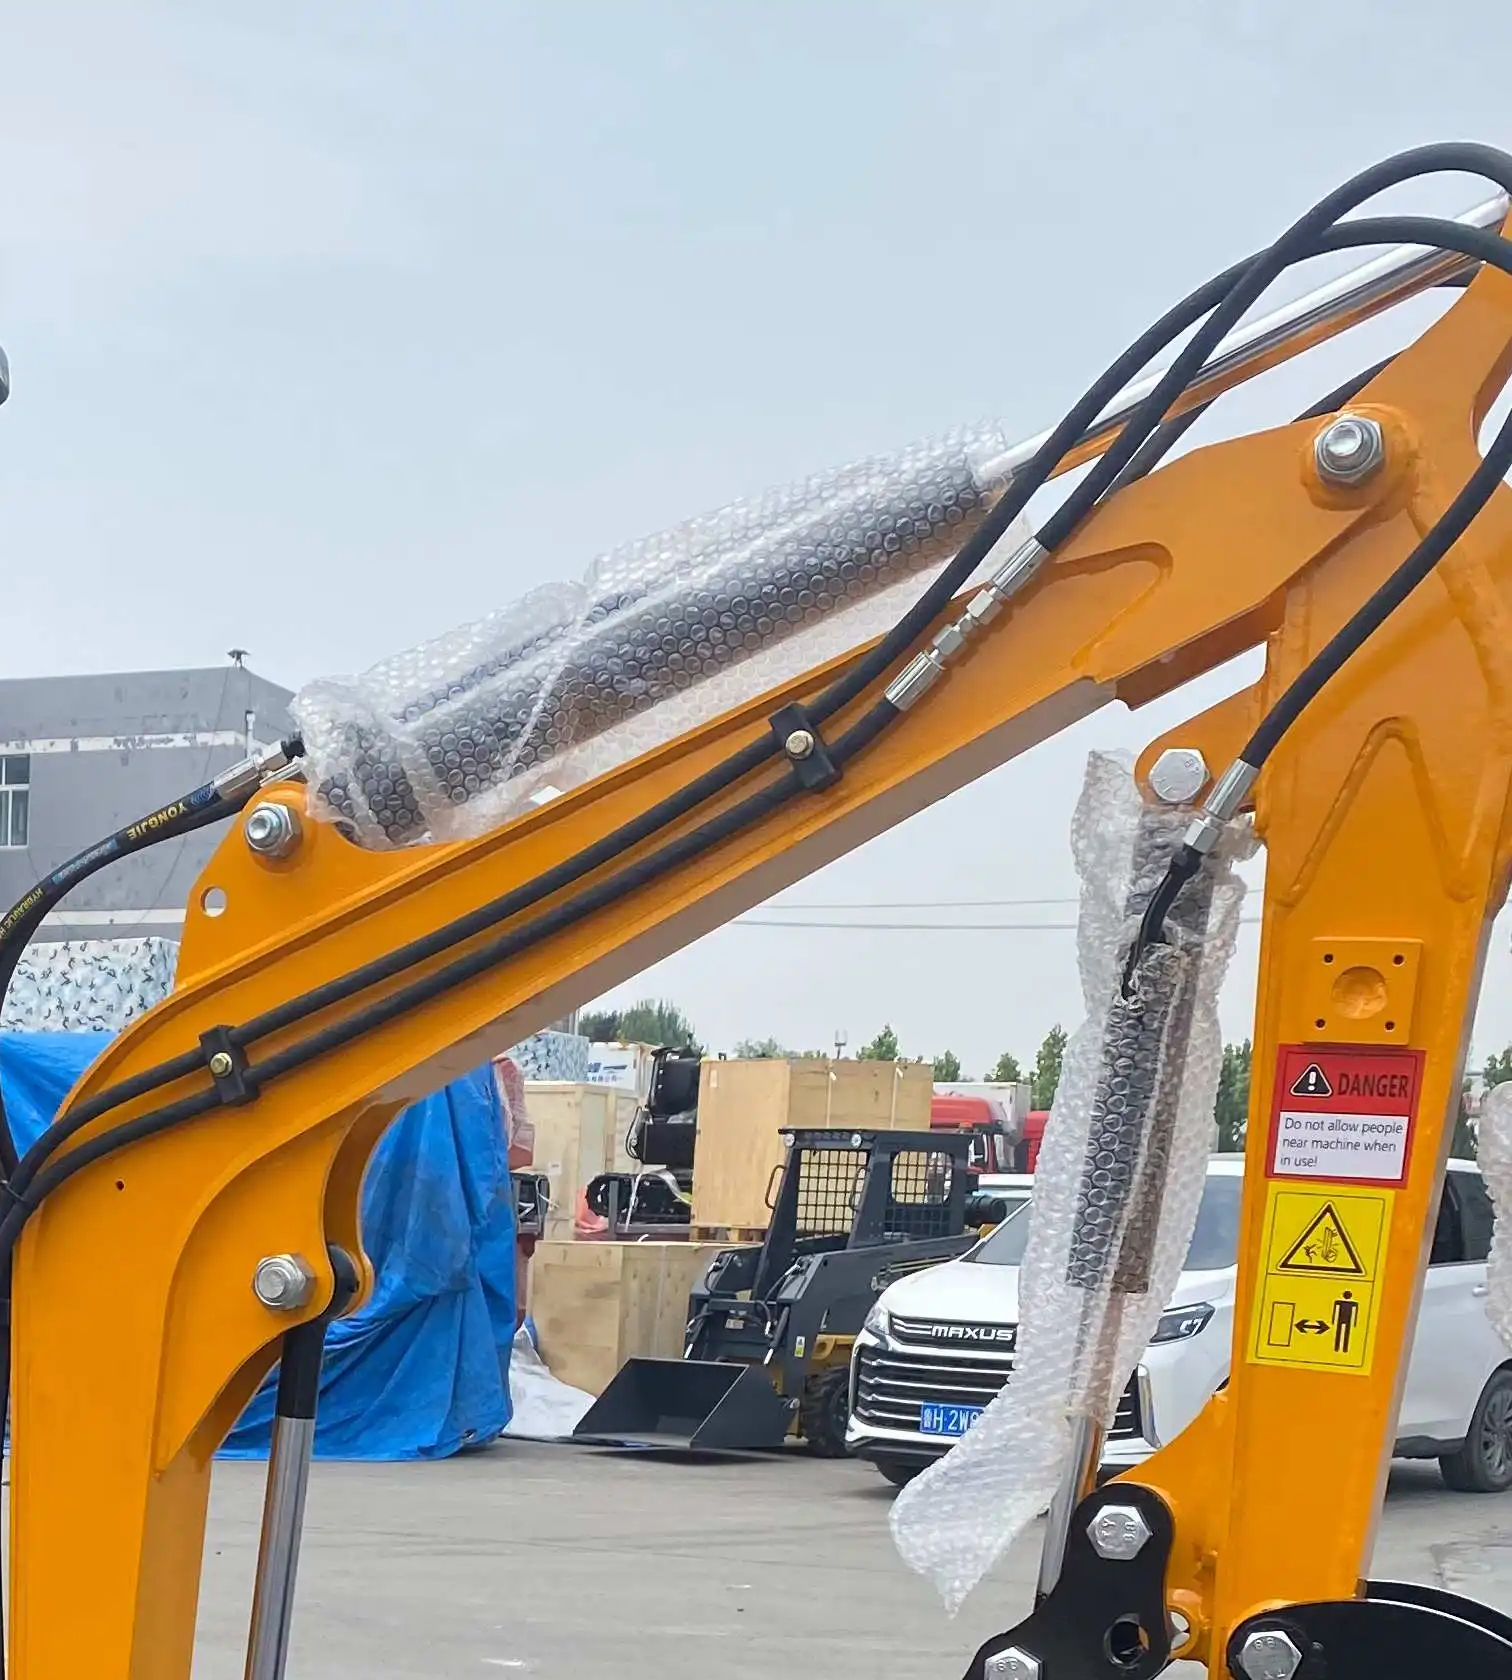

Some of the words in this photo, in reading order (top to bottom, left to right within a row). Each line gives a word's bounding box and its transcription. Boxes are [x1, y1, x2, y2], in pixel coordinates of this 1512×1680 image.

[126, 801, 188, 840] YONGJIE
[1338, 1072, 1409, 1099] DANGER
[1284, 1117, 1302, 1130] Do
[1304, 1119, 1325, 1131] not
[1327, 1119, 1359, 1133] allow
[1361, 1122, 1403, 1137] people
[1282, 1136, 1308, 1149] near
[1311, 1138, 1361, 1150] machine
[1363, 1140, 1396, 1151] when
[1280, 1154, 1291, 1167] in
[1294, 1156, 1318, 1168] use!
[931, 1326, 1014, 1341] MAXUS
